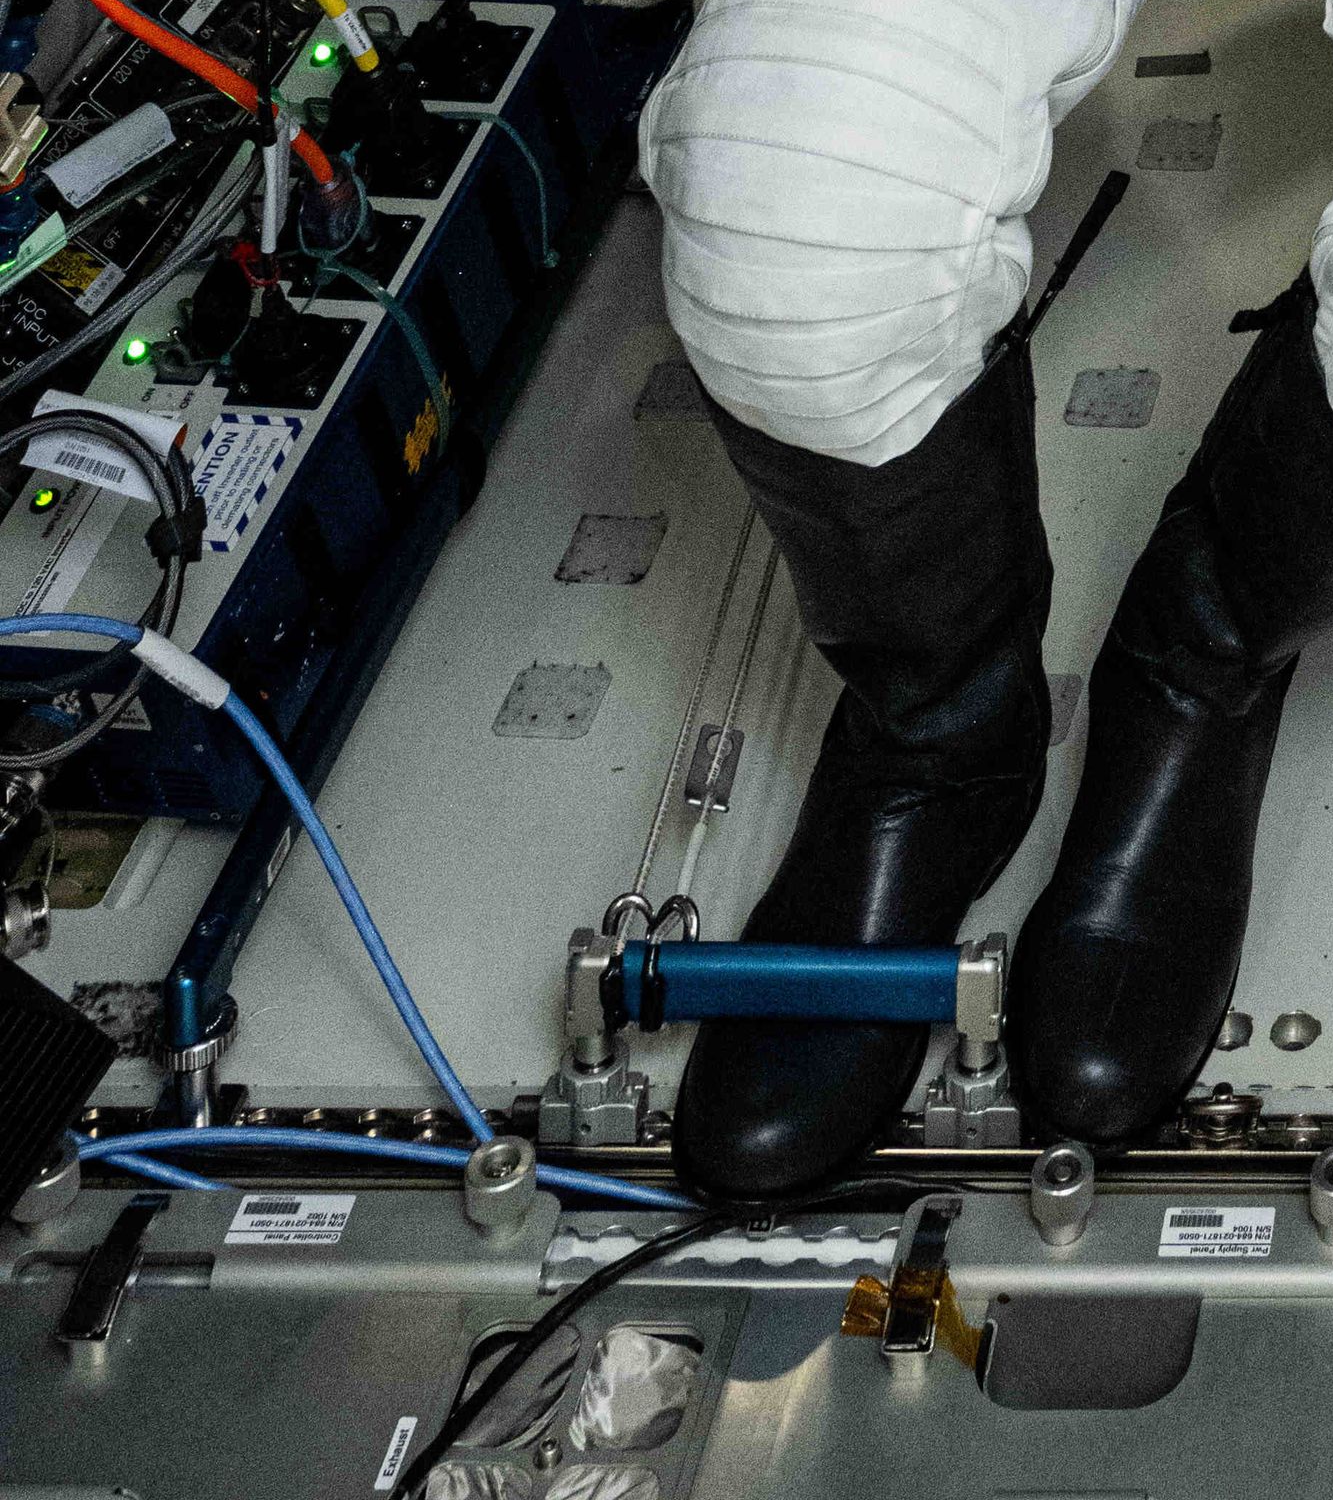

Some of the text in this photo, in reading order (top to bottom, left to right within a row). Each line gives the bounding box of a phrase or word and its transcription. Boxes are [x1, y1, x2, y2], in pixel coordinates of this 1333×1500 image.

[330, 1213, 346, 1221] S/N
[327, 1220, 343, 1229] P/N
[1255, 1225, 1271, 1233] S/N
[263, 1232, 338, 1242] Controller Panel
[1254, 1232, 1270, 1240] P/N
[1189, 1242, 1268, 1254] Pwr Supply Panel
[383, 1425, 412, 1481] Exhaust
